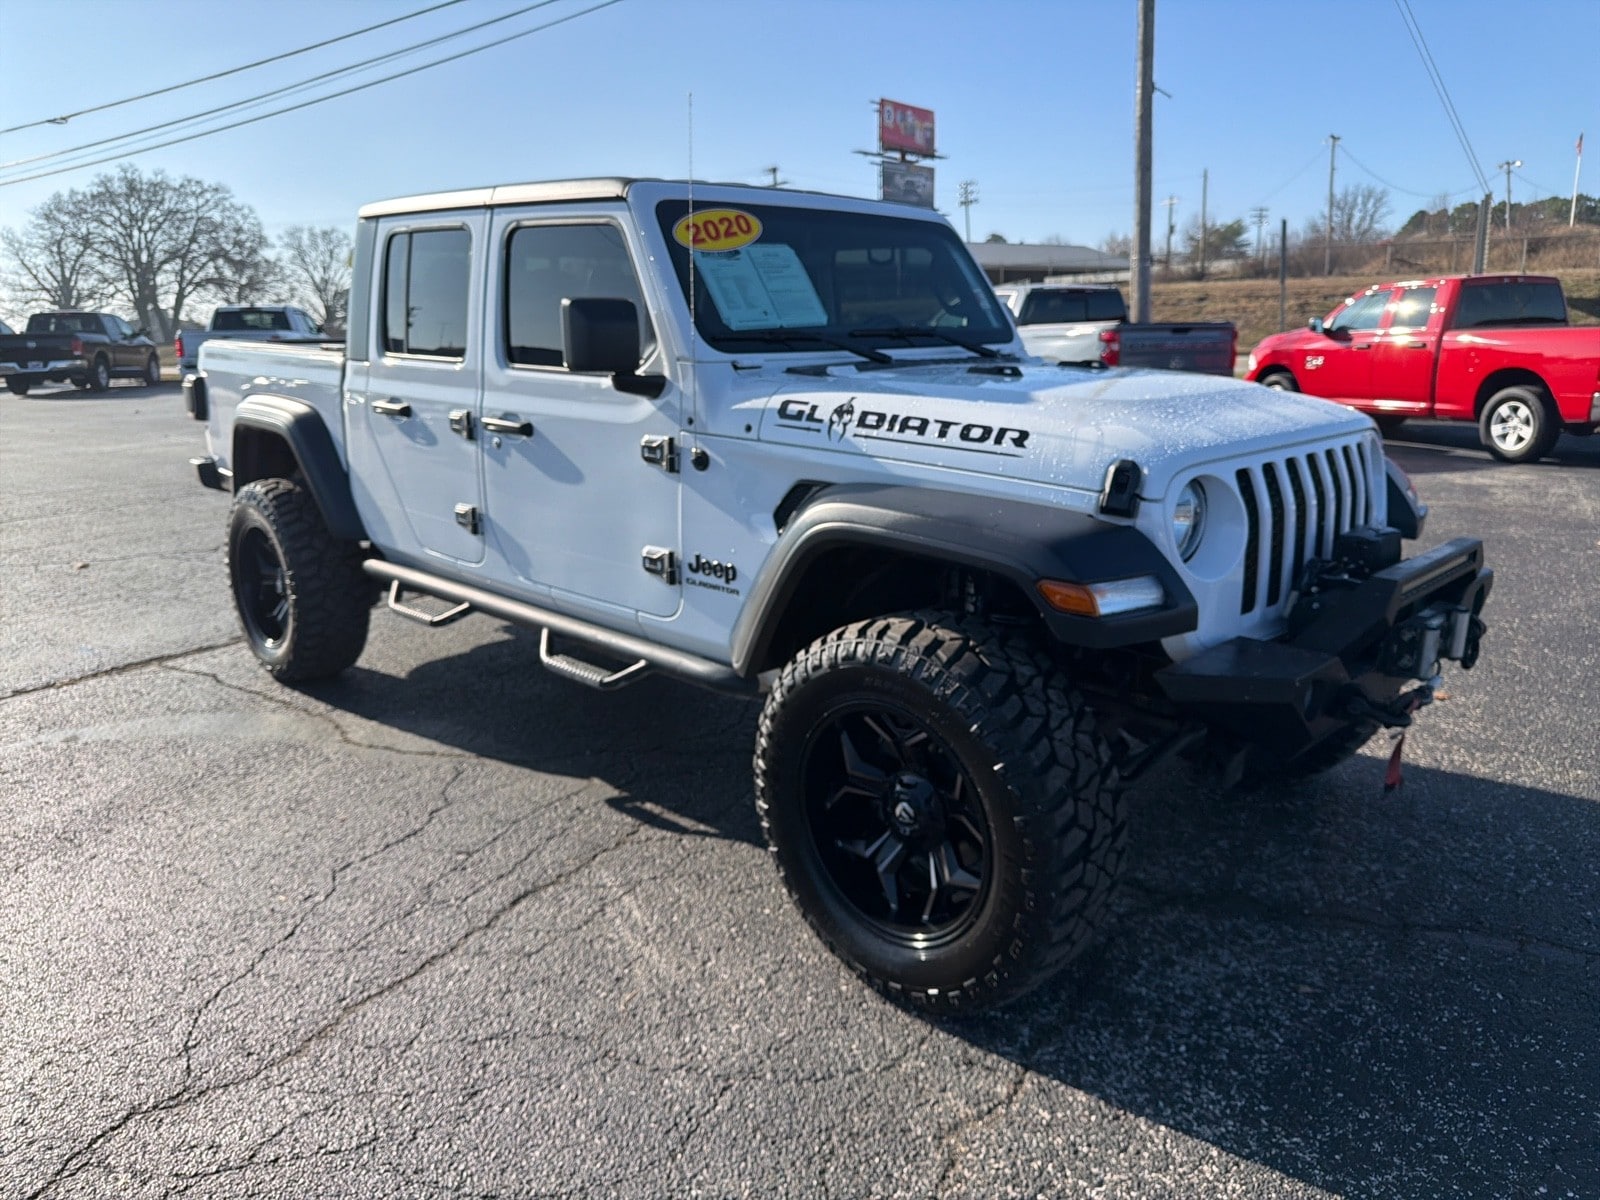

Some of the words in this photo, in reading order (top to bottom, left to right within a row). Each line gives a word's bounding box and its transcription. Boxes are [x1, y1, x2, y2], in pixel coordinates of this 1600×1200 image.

[685, 214, 752, 246] 2020
[688, 554, 737, 583] Jeep
[686, 577, 740, 595] GLADIATOR
